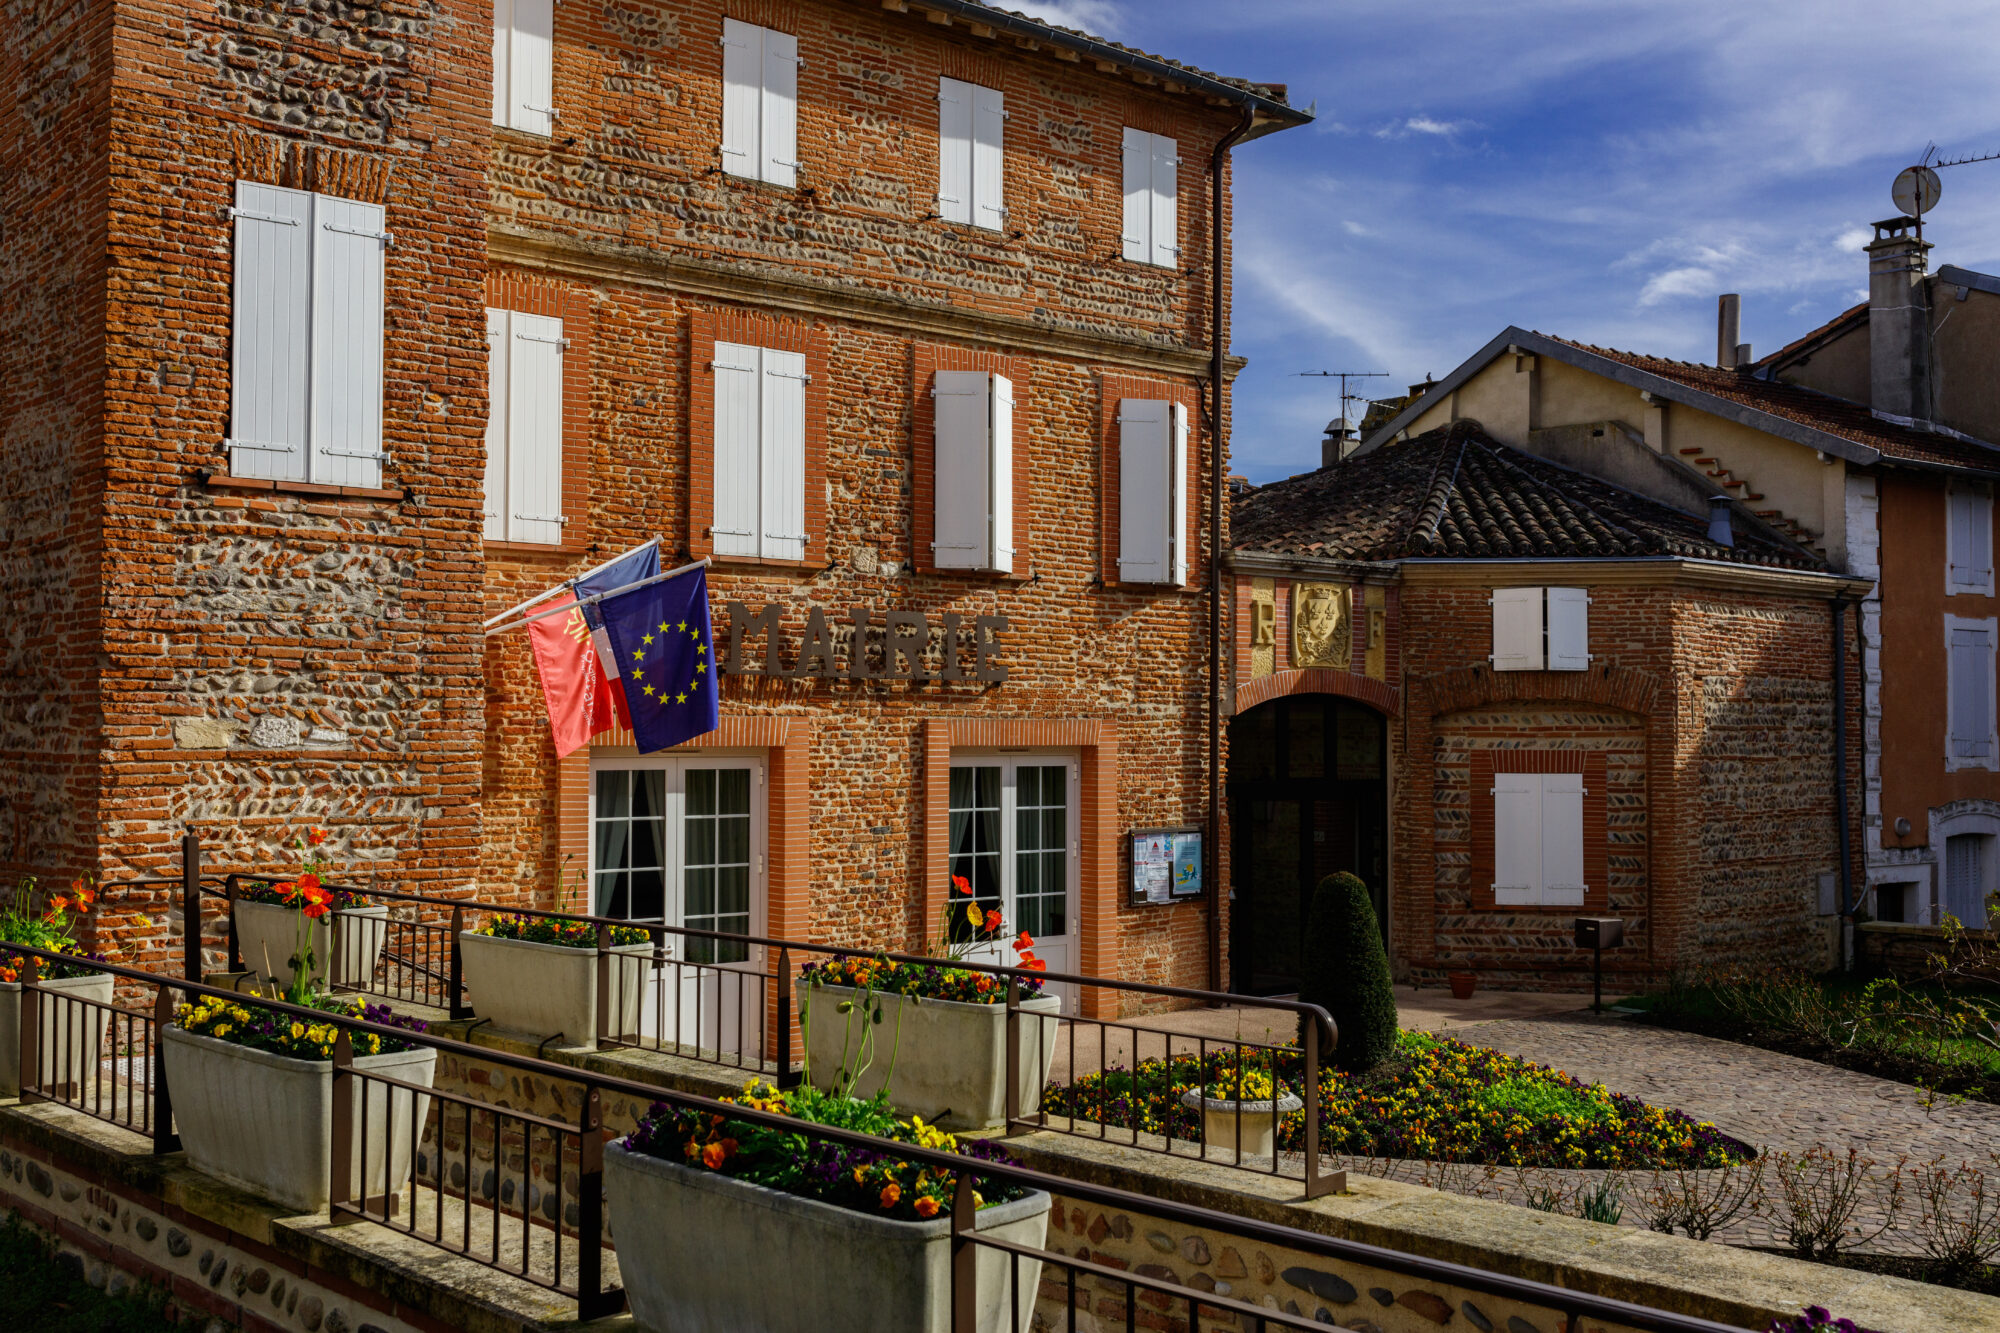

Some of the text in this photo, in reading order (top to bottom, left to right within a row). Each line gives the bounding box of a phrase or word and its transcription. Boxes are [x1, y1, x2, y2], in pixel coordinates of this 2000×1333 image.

[726, 601, 1009, 681] MAIRIE
[1254, 600, 1386, 647] R F
